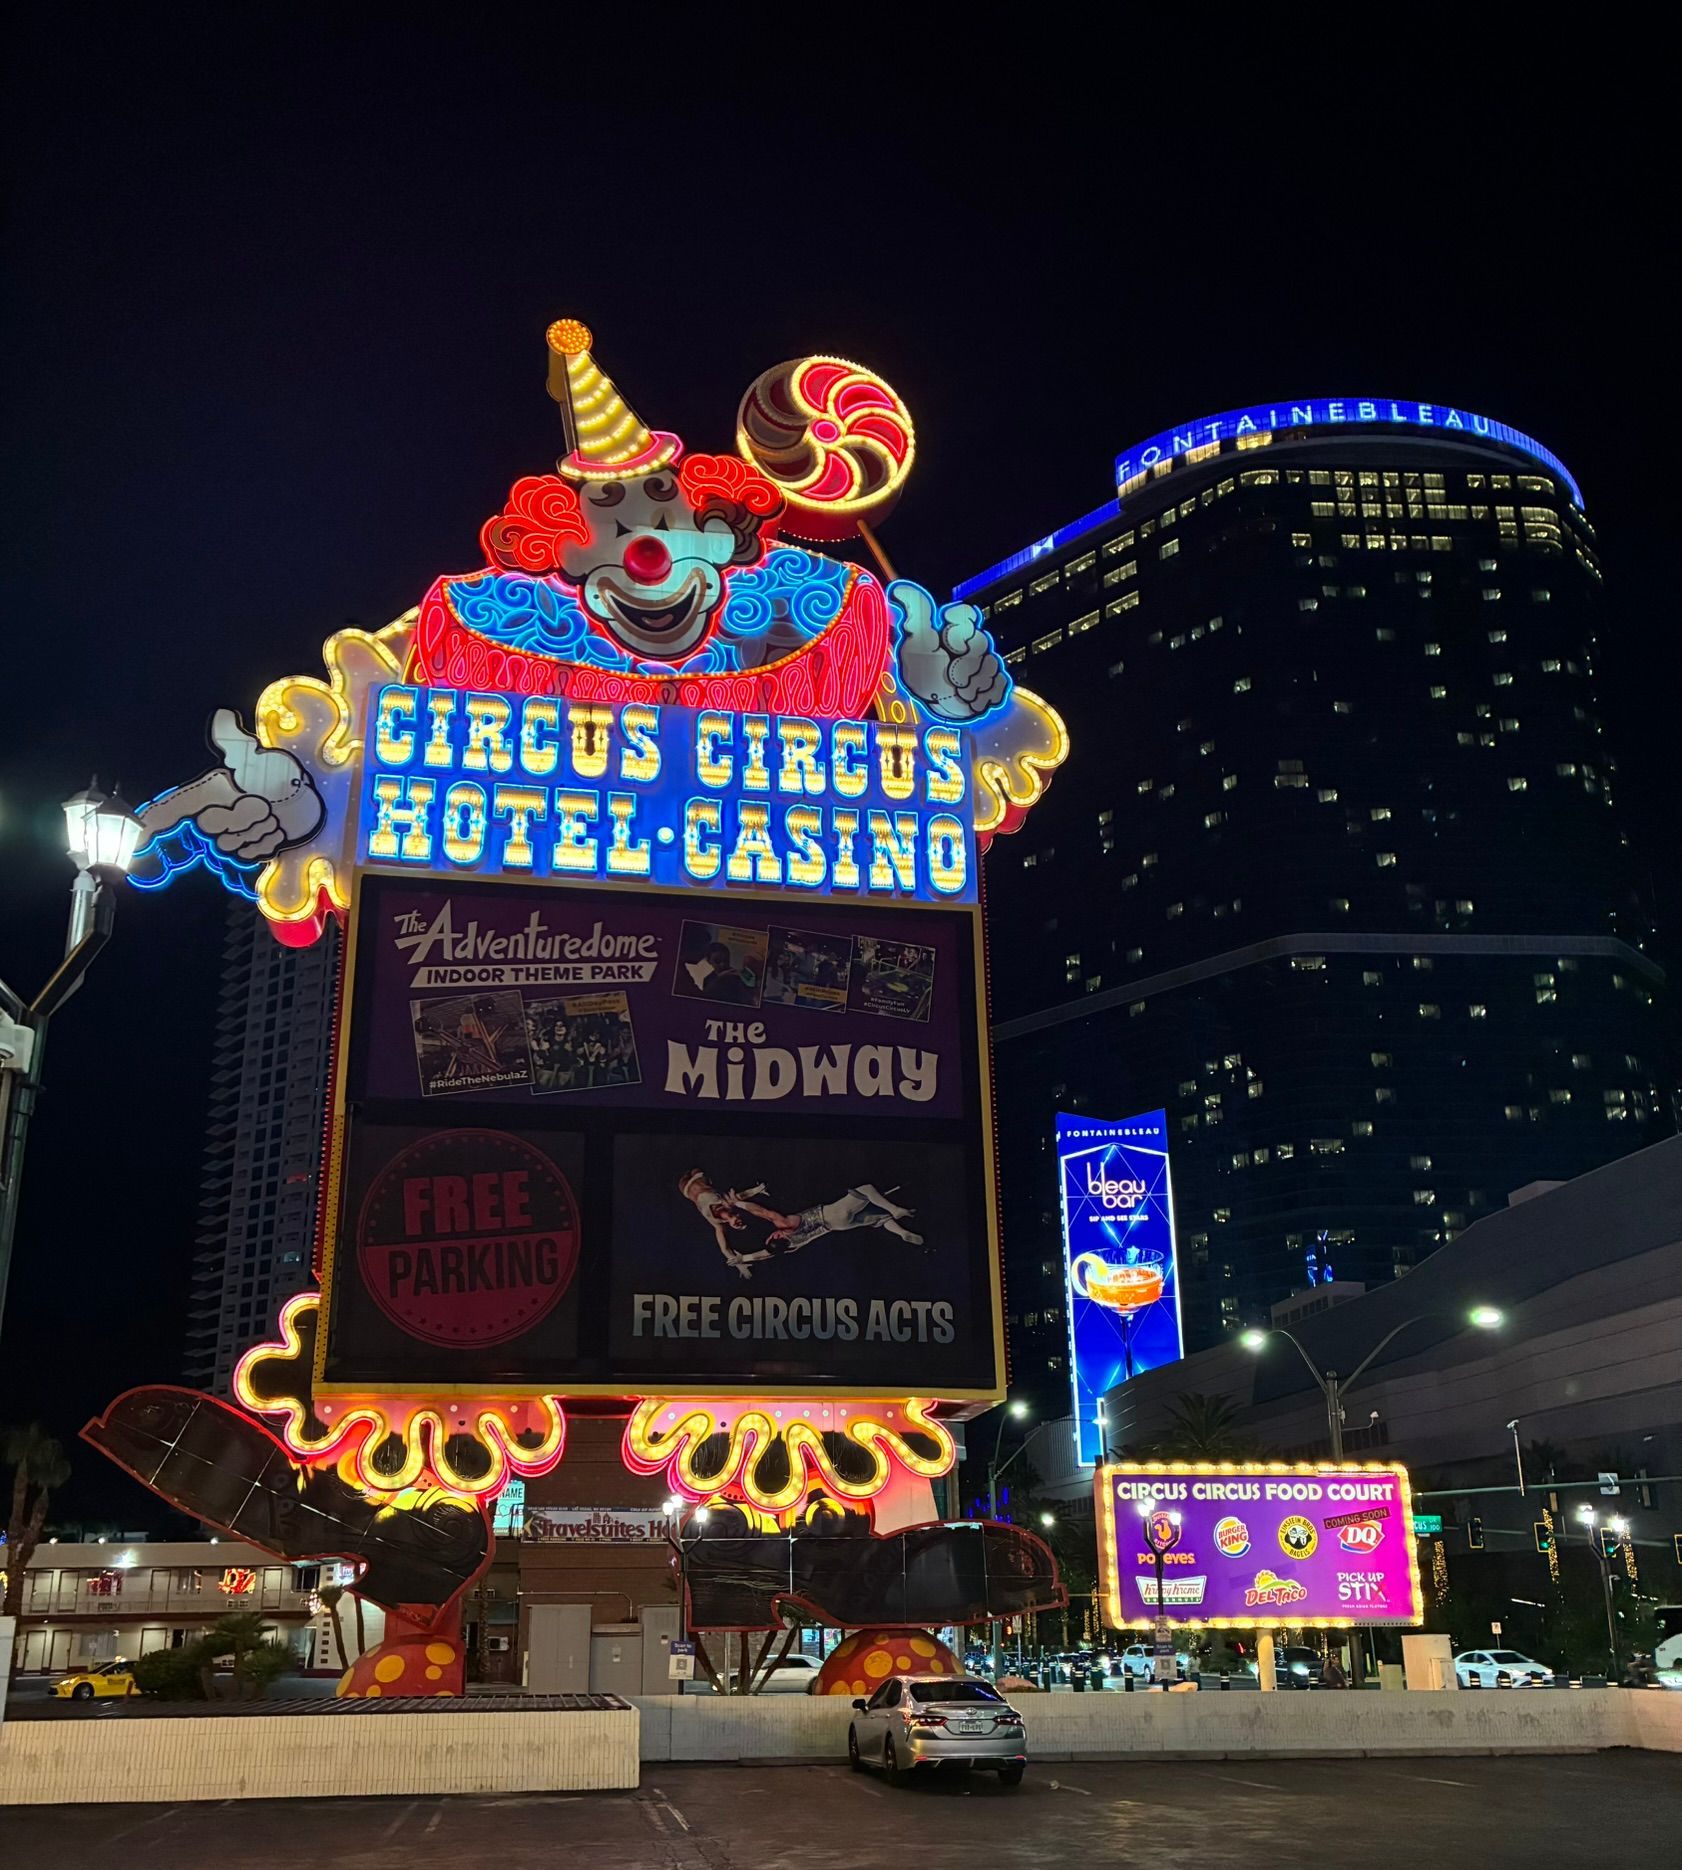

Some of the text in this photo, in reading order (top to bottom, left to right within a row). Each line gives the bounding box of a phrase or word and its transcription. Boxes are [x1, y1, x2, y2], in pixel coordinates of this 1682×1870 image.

[1118, 402, 1489, 482] FONTAINEBLEAU
[375, 684, 966, 805] CIRCUS CIRCUS
[368, 774, 967, 894] HOTEL CASINO
[394, 899, 659, 965] The Adventuredome
[426, 964, 645, 984] INDOOR THEME PARK
[429, 1069, 529, 1089] #RideTheNebulaZ
[1066, 1127, 1160, 1138] FONTAINEBLEAU
[1086, 1161, 1146, 1195] bleau
[403, 1170, 534, 1236] FREE
[1102, 1195, 1143, 1209] bar
[388, 1238, 559, 1299] PARKING
[632, 1293, 956, 1344] FREE CIRCUS ACTS
[1117, 1482, 1394, 1501] CIRCUS CIRCUS FOOD COURT
[540, 1518, 646, 1538] Travelsuites
[1325, 1508, 1388, 1529] COMING SOON
[1218, 1525, 1246, 1539] BURGER
[1219, 1532, 1248, 1548] KING
[1346, 1526, 1377, 1546] DQ
[1137, 1553, 1196, 1565] POEYES
[1336, 1572, 1385, 1582] PICK UP
[1245, 1587, 1307, 1605] DEL TACO
